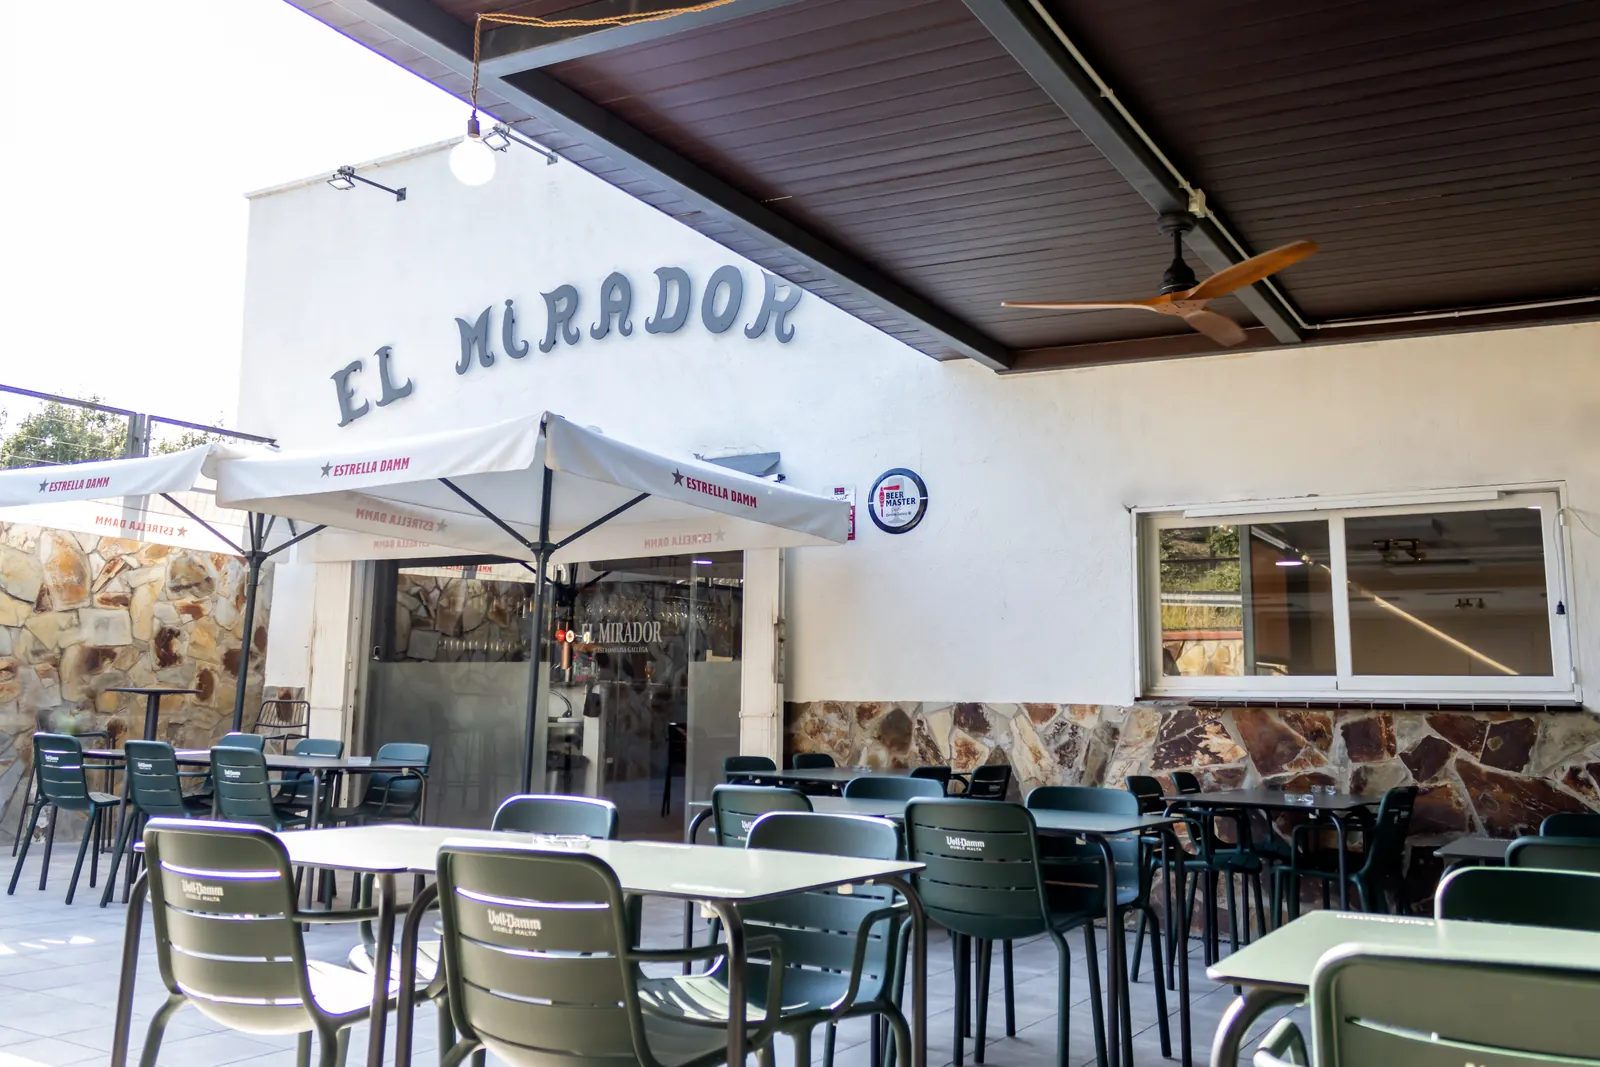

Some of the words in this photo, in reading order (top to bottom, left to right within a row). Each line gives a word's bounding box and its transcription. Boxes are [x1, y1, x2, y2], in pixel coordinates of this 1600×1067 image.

[330, 346, 412, 427] EL
[333, 461, 379, 477] ESTRELLA
[380, 457, 410, 472] DAMM
[49, 479, 85, 492] ESTRELLA
[85, 476, 111, 489] DAMM
[686, 476, 729, 500] ESTRELLA
[730, 489, 757, 508] DAMM
[886, 491, 904, 500] BEER
[886, 498, 916, 507] MASTER
[598, 620, 662, 643] MIRADOR
[515, 929, 537, 937] MALTA
